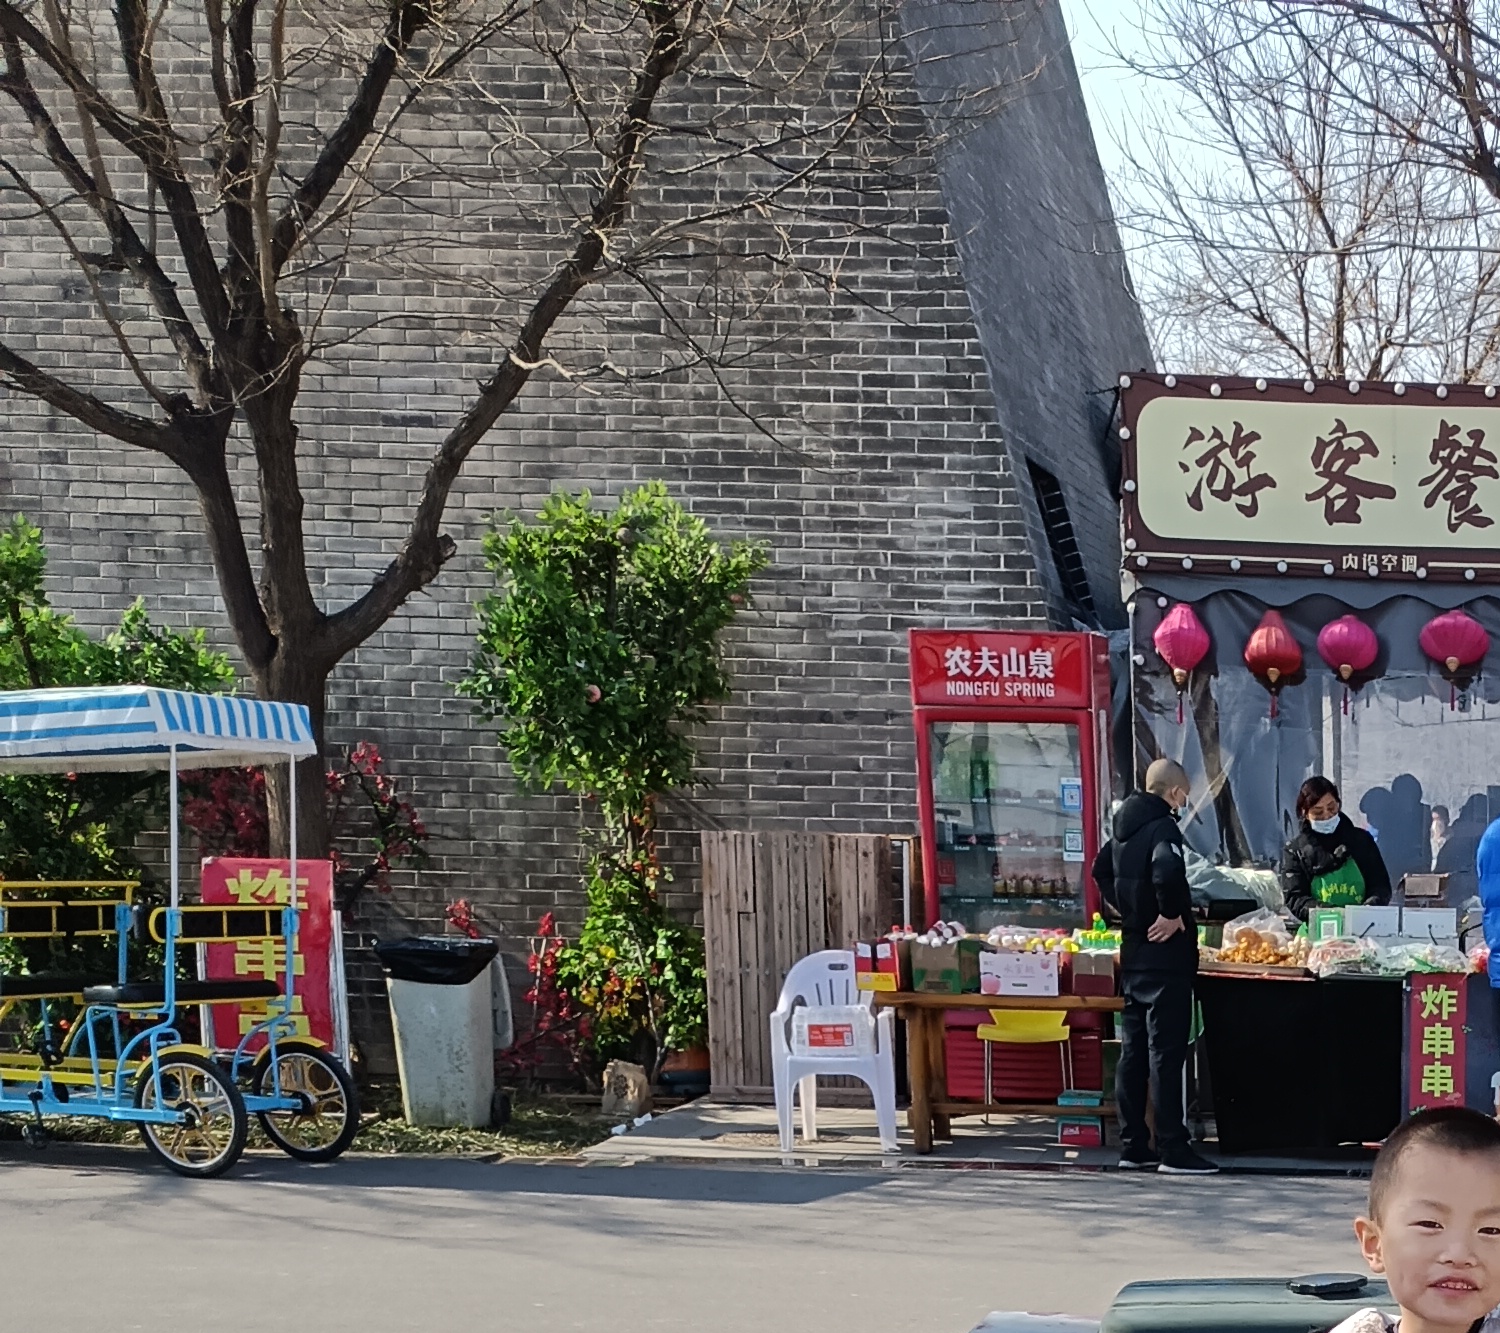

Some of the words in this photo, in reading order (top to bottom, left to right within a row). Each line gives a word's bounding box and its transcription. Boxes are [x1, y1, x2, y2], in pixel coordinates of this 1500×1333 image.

[1342, 552, 1418, 573] 内设空调
[944, 645, 1055, 679] 农夫山泉
[946, 681, 1000, 697] NONGFU
[1004, 682, 1055, 697] SPRING
[1420, 983, 1459, 1098] 炸串串
